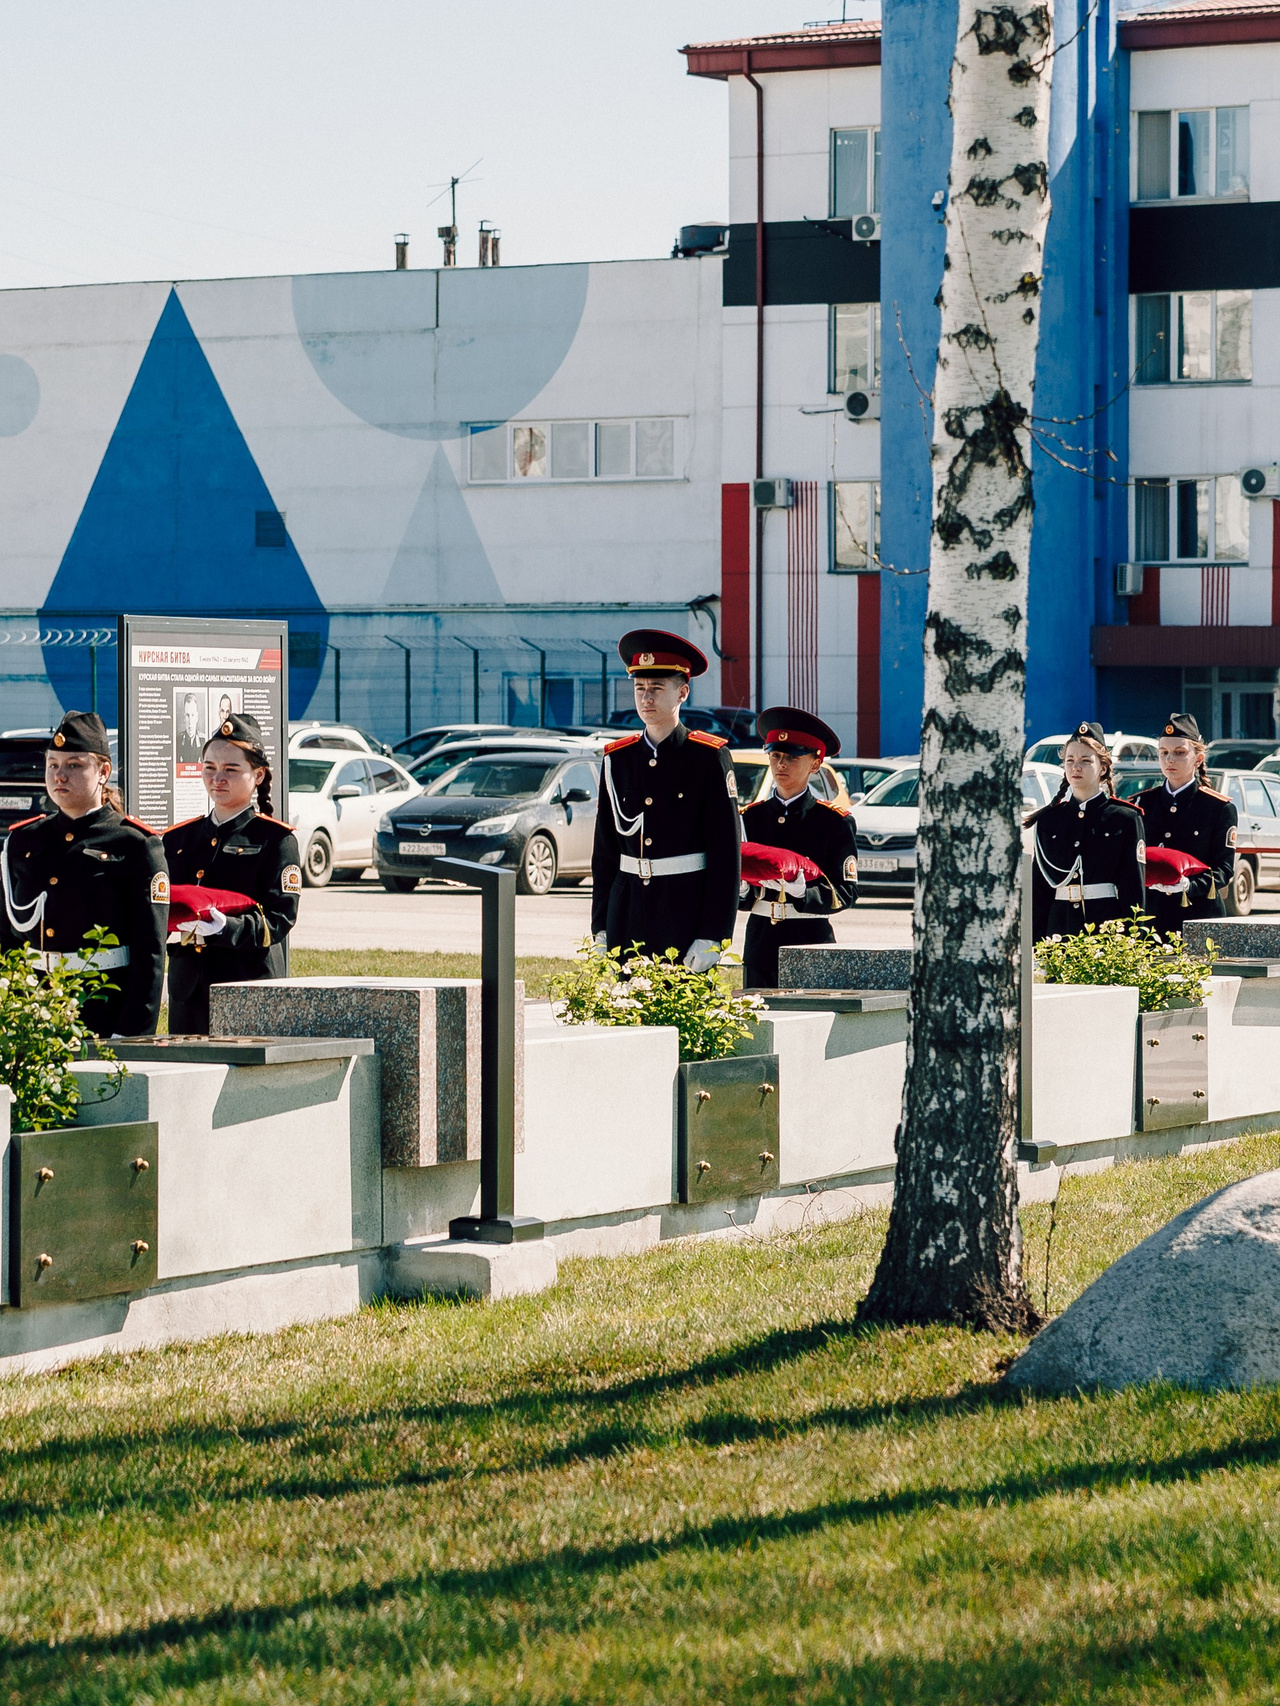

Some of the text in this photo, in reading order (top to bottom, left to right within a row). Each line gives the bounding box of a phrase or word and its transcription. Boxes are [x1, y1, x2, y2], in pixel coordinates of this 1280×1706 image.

[138, 651, 190, 664] КУРСКАЯ БИТВА
[138, 673, 157, 681] КУРСКАЯ
[157, 673, 170, 681] БИТВА
[184, 673, 199, 682] ОДНОЙ
[205, 674, 220, 682] САМЫХ
[220, 674, 247, 683] МАСШТАБНЫХ
[253, 675, 263, 683] ВСЮ
[263, 674, 276, 683] ВОЙНУ
